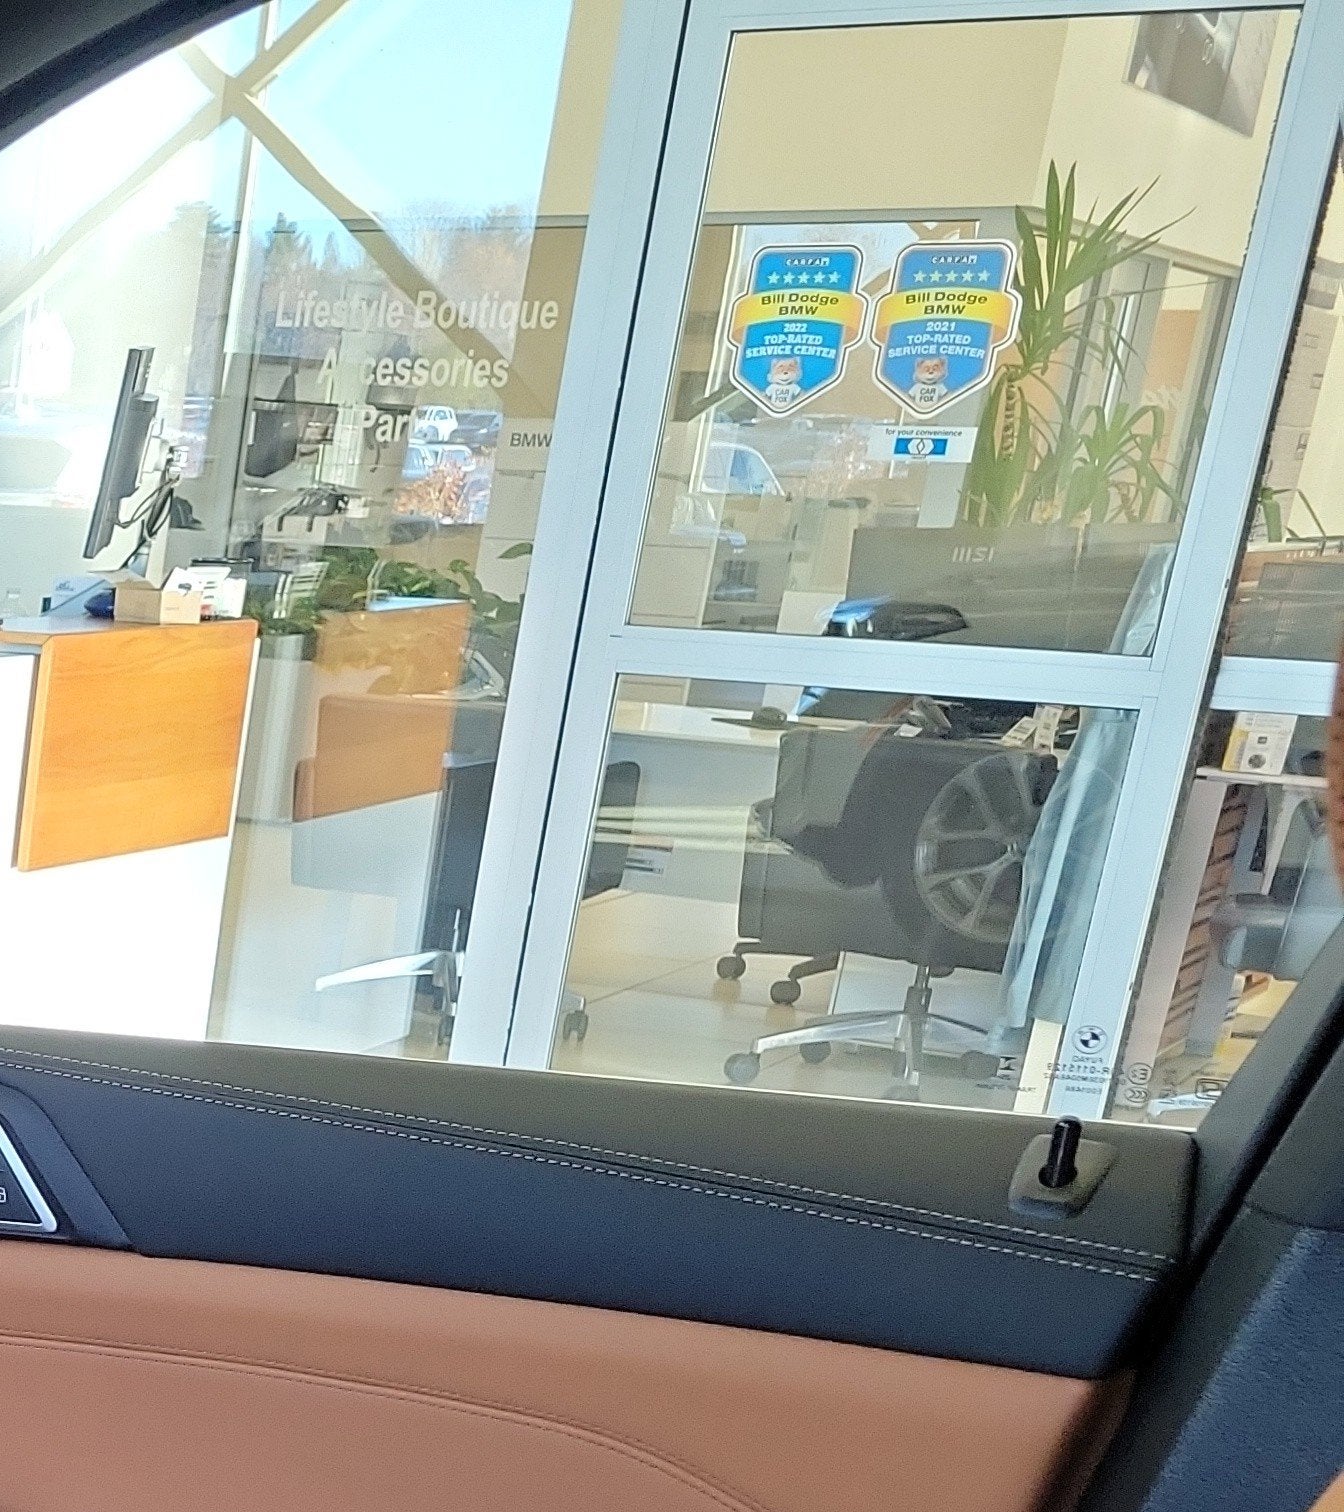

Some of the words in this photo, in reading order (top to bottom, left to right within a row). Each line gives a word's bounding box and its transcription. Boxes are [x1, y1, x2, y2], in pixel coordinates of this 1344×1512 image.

[761, 294, 785, 306] Bill
[788, 293, 839, 306] Dodge
[905, 293, 930, 304] Bill
[934, 292, 988, 304] Dodge
[274, 290, 405, 332] Lifestyle
[414, 290, 560, 336] Boutique
[778, 305, 819, 316] BMW
[923, 304, 966, 315] BMW
[783, 322, 807, 333] 2022
[925, 321, 956, 332] 2021
[763, 333, 823, 346] TOP-RATED
[906, 333, 972, 345] TOP-RATED
[745, 345, 792, 359] SERVICE
[794, 345, 837, 359] CENTER
[888, 344, 937, 359] SERVICE
[939, 344, 986, 359] CENTER
[316, 348, 510, 389] Acessories
[919, 387, 937, 396] CAR
[885, 427, 896, 436] for
[897, 429, 914, 438] your
[915, 428, 963, 438] convenience
[510, 432, 554, 448] BMW
